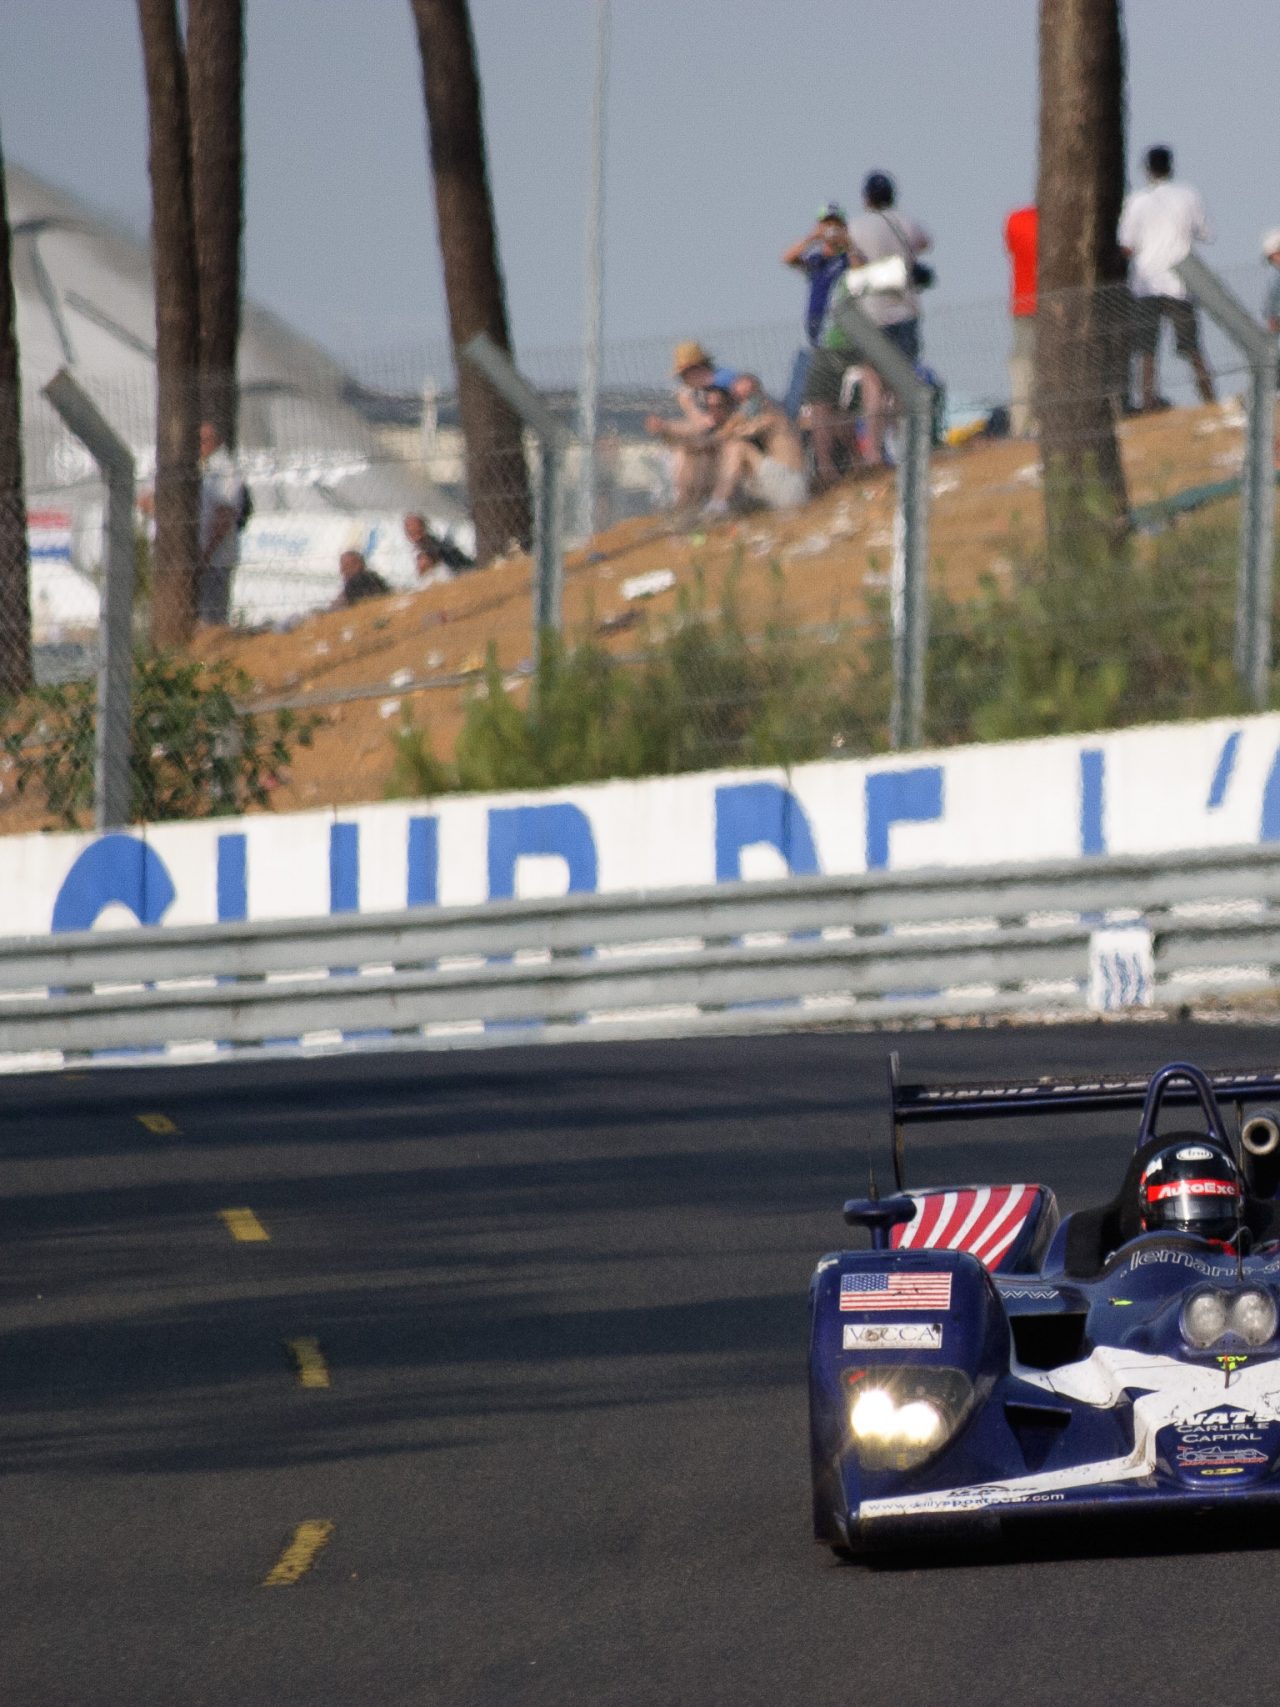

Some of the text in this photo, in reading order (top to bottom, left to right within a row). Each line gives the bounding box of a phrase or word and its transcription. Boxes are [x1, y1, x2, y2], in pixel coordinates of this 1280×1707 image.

[849, 1326, 936, 1342] VCCA
[1176, 1422, 1270, 1433] CARLISLE
[1182, 1433, 1262, 1444] CAPITAL
